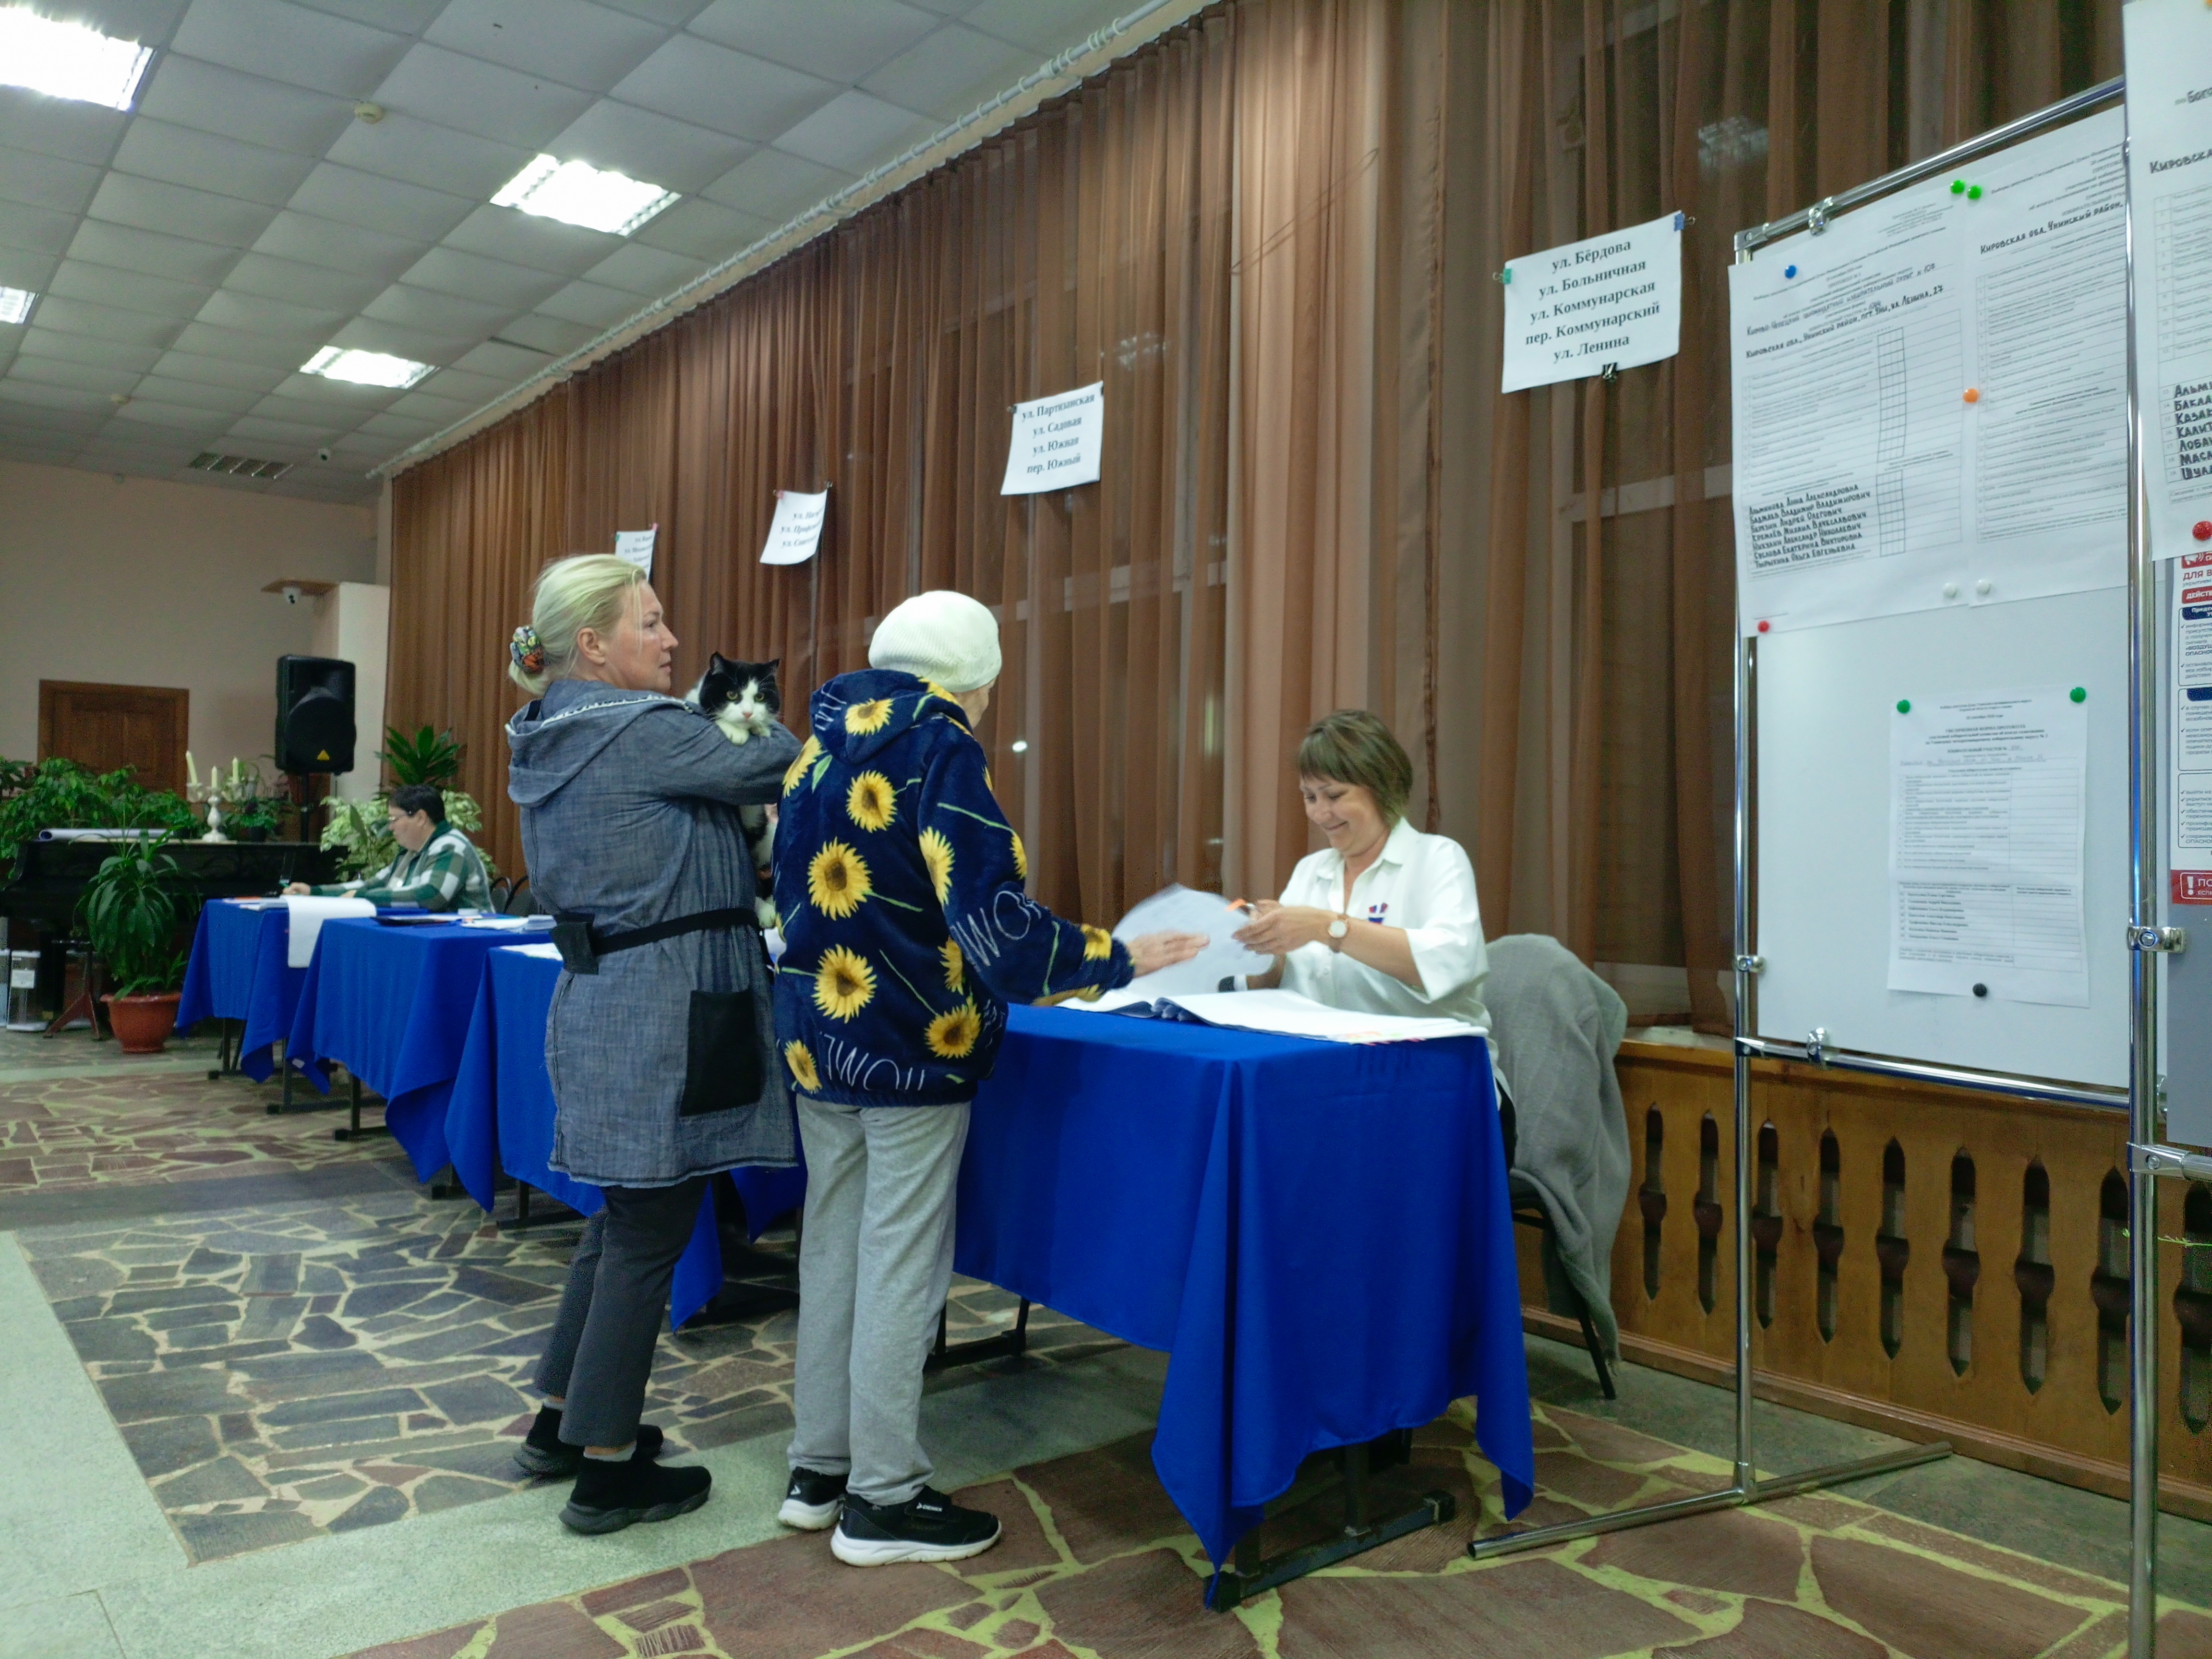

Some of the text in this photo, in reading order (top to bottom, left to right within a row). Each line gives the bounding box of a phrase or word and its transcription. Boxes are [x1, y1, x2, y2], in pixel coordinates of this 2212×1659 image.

[1551, 241, 1631, 273] ул. Бёрдова
[1539, 261, 1647, 300] ул. Больничная
[1530, 282, 1656, 325] ул. Коммунарская
[1526, 301, 1660, 345] пер. Коммунарский
[1553, 337, 1630, 363] ул. Ленина
[1022, 395, 1095, 422] ул. Партизанская
[1033, 418, 1082, 438] ул. Садовая
[1033, 437, 1079, 457] ул. Южная
[1027, 453, 1081, 475] пер. Южный
[2183, 570, 2203, 581] ДЛЯ
